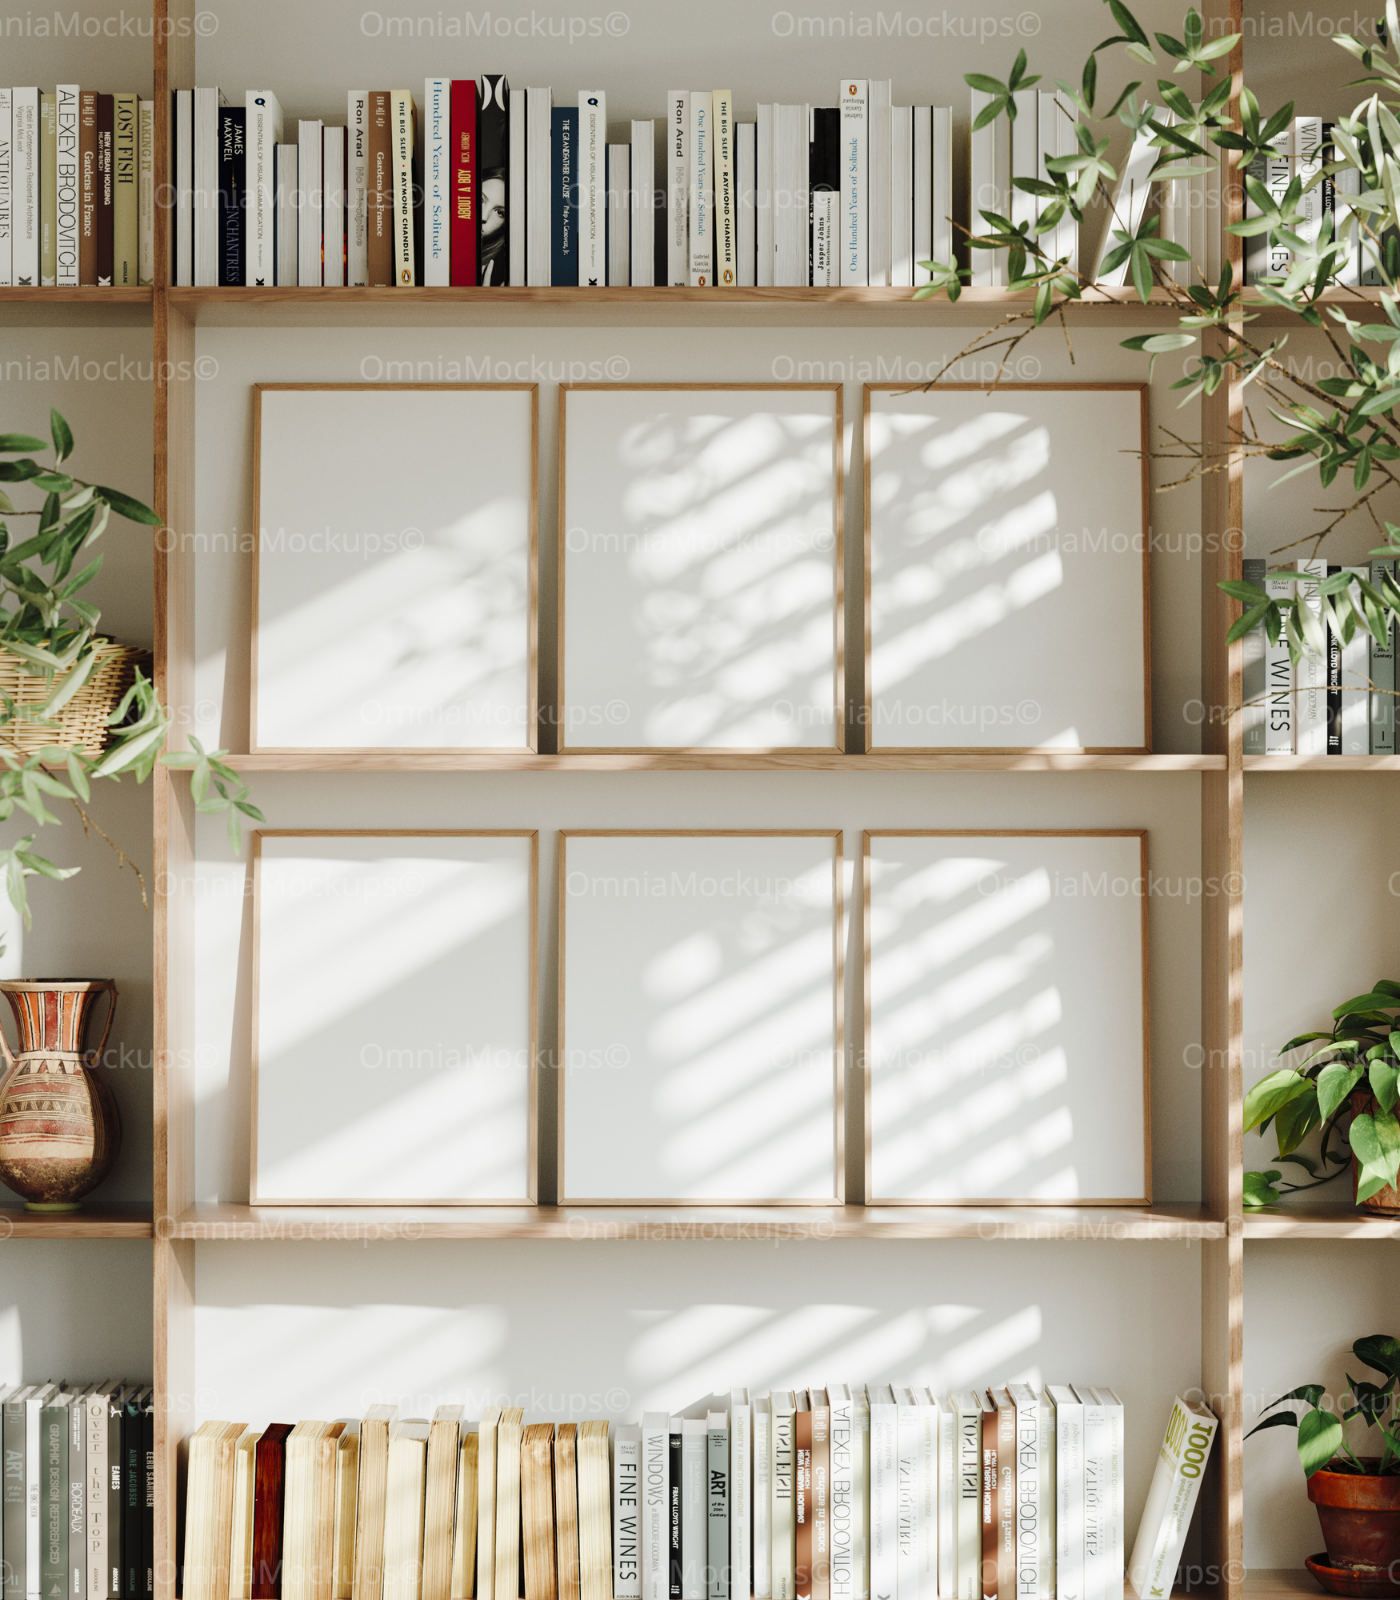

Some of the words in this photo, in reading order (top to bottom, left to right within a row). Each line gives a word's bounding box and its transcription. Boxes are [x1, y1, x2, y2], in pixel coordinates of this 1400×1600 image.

[16, 106, 24, 128] Virginia
[59, 89, 76, 158] ALEXEY
[118, 99, 133, 142] LOST
[356, 100, 364, 124] Ron
[432, 81, 442, 140] Hundred
[676, 100, 684, 124] Ron
[697, 110, 705, 127] One
[141, 109, 151, 157] MAKING
[224, 117, 232, 162] MAXWELL
[234, 124, 243, 155] JAMES
[356, 128, 364, 157] Arad
[461, 132, 469, 150] HORNBY
[676, 128, 684, 157] Arad
[697, 130, 705, 166] Hundred
[25, 130, 33, 170] Contemporary
[118, 147, 133, 184] FISH
[141, 160, 151, 172] IT
[432, 145, 442, 180] Years
[461, 152, 469, 163] NICK
[849, 137, 858, 172] Solitude
[84, 151, 93, 190] Gardens
[376, 152, 385, 190] Gardens
[457, 169, 471, 184] BOY
[697, 168, 705, 189] Years
[849, 175, 858, 185] of
[1271, 155, 1289, 198] FINE
[84, 192, 93, 202] in
[376, 192, 385, 202] in
[432, 185, 442, 200] of
[457, 195, 471, 219] ABOUT
[697, 191, 705, 202] of
[849, 186, 858, 210] Years
[59, 164, 76, 277] BRODOVITCH
[84, 204, 93, 237] France
[376, 204, 385, 237] France
[432, 205, 442, 259] Solitude
[697, 203, 705, 236] Solitude
[849, 212, 858, 250] Hundred
[226, 205, 239, 282] ENCHANTRESS
[817, 243, 825, 271] Jasper
[849, 252, 858, 271] One
[1270, 659, 1290, 731] WINES
[49, 1424, 60, 1465] GRAPHIC
[90, 1405, 103, 1452] Over
[6, 1449, 23, 1480] ART
[129, 1449, 137, 1467] ARNE
[648, 1434, 663, 1506] WINDOWS
[30, 1484, 38, 1492] THE
[49, 1467, 60, 1501] DESIGN
[91, 1467, 101, 1500] the
[112, 1465, 120, 1490] EAMES
[129, 1470, 137, 1507] JACOBSEN
[620, 1463, 637, 1506] FINE
[711, 1470, 726, 1498] ART
[71, 1482, 82, 1533] BORDEAUX
[49, 1504, 60, 1564] REFERENCED
[620, 1515, 637, 1580] WINES
